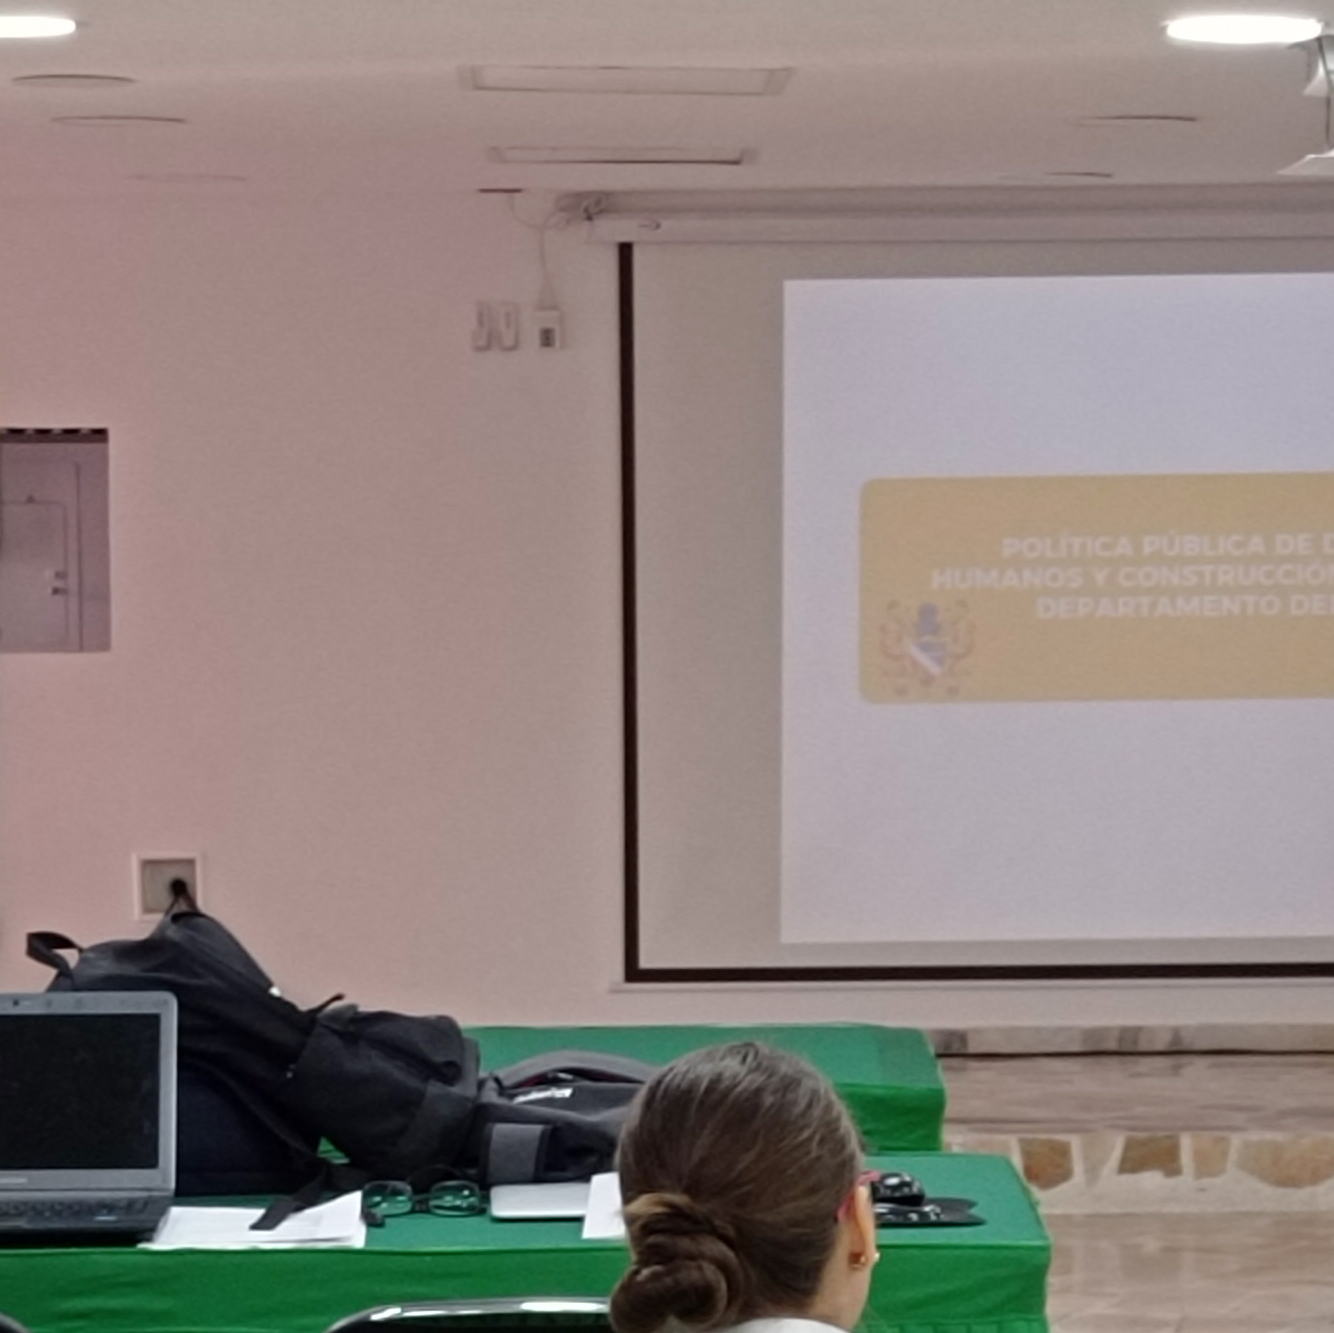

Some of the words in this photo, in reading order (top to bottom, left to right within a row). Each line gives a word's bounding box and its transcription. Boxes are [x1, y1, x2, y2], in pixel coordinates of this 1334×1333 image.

[1001, 532, 1134, 559] POLÍTICA
[1142, 529, 1266, 557] PÚBLICA
[1275, 533, 1315, 556] DE
[931, 566, 1084, 590] HUMANOS
[1091, 565, 1112, 588] Y
[1036, 594, 1283, 620] DEPARTAMENTO
